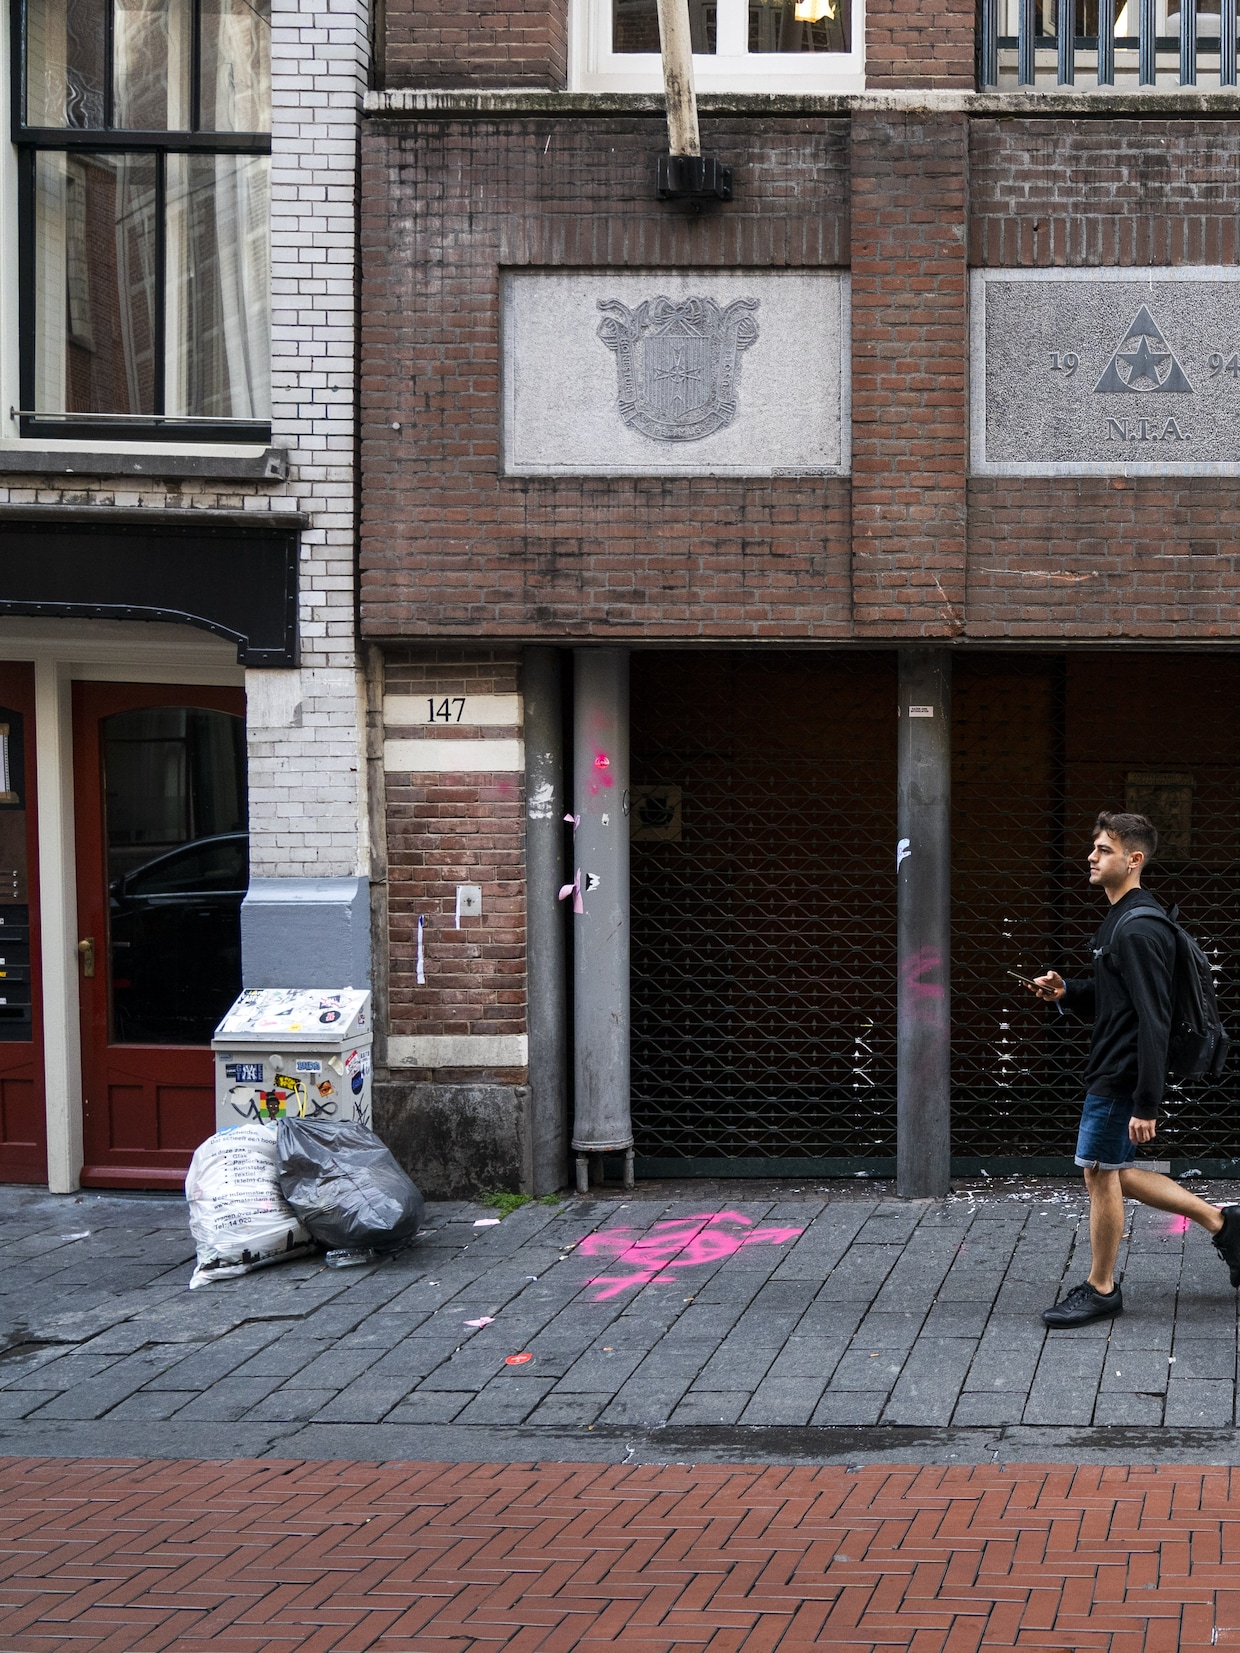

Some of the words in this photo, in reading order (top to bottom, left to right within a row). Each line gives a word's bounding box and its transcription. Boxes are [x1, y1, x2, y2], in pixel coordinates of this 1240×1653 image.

[1049, 352, 1080, 378] 19
[1106, 417, 1192, 441] N.I.A.
[427, 697, 466, 722] 147
